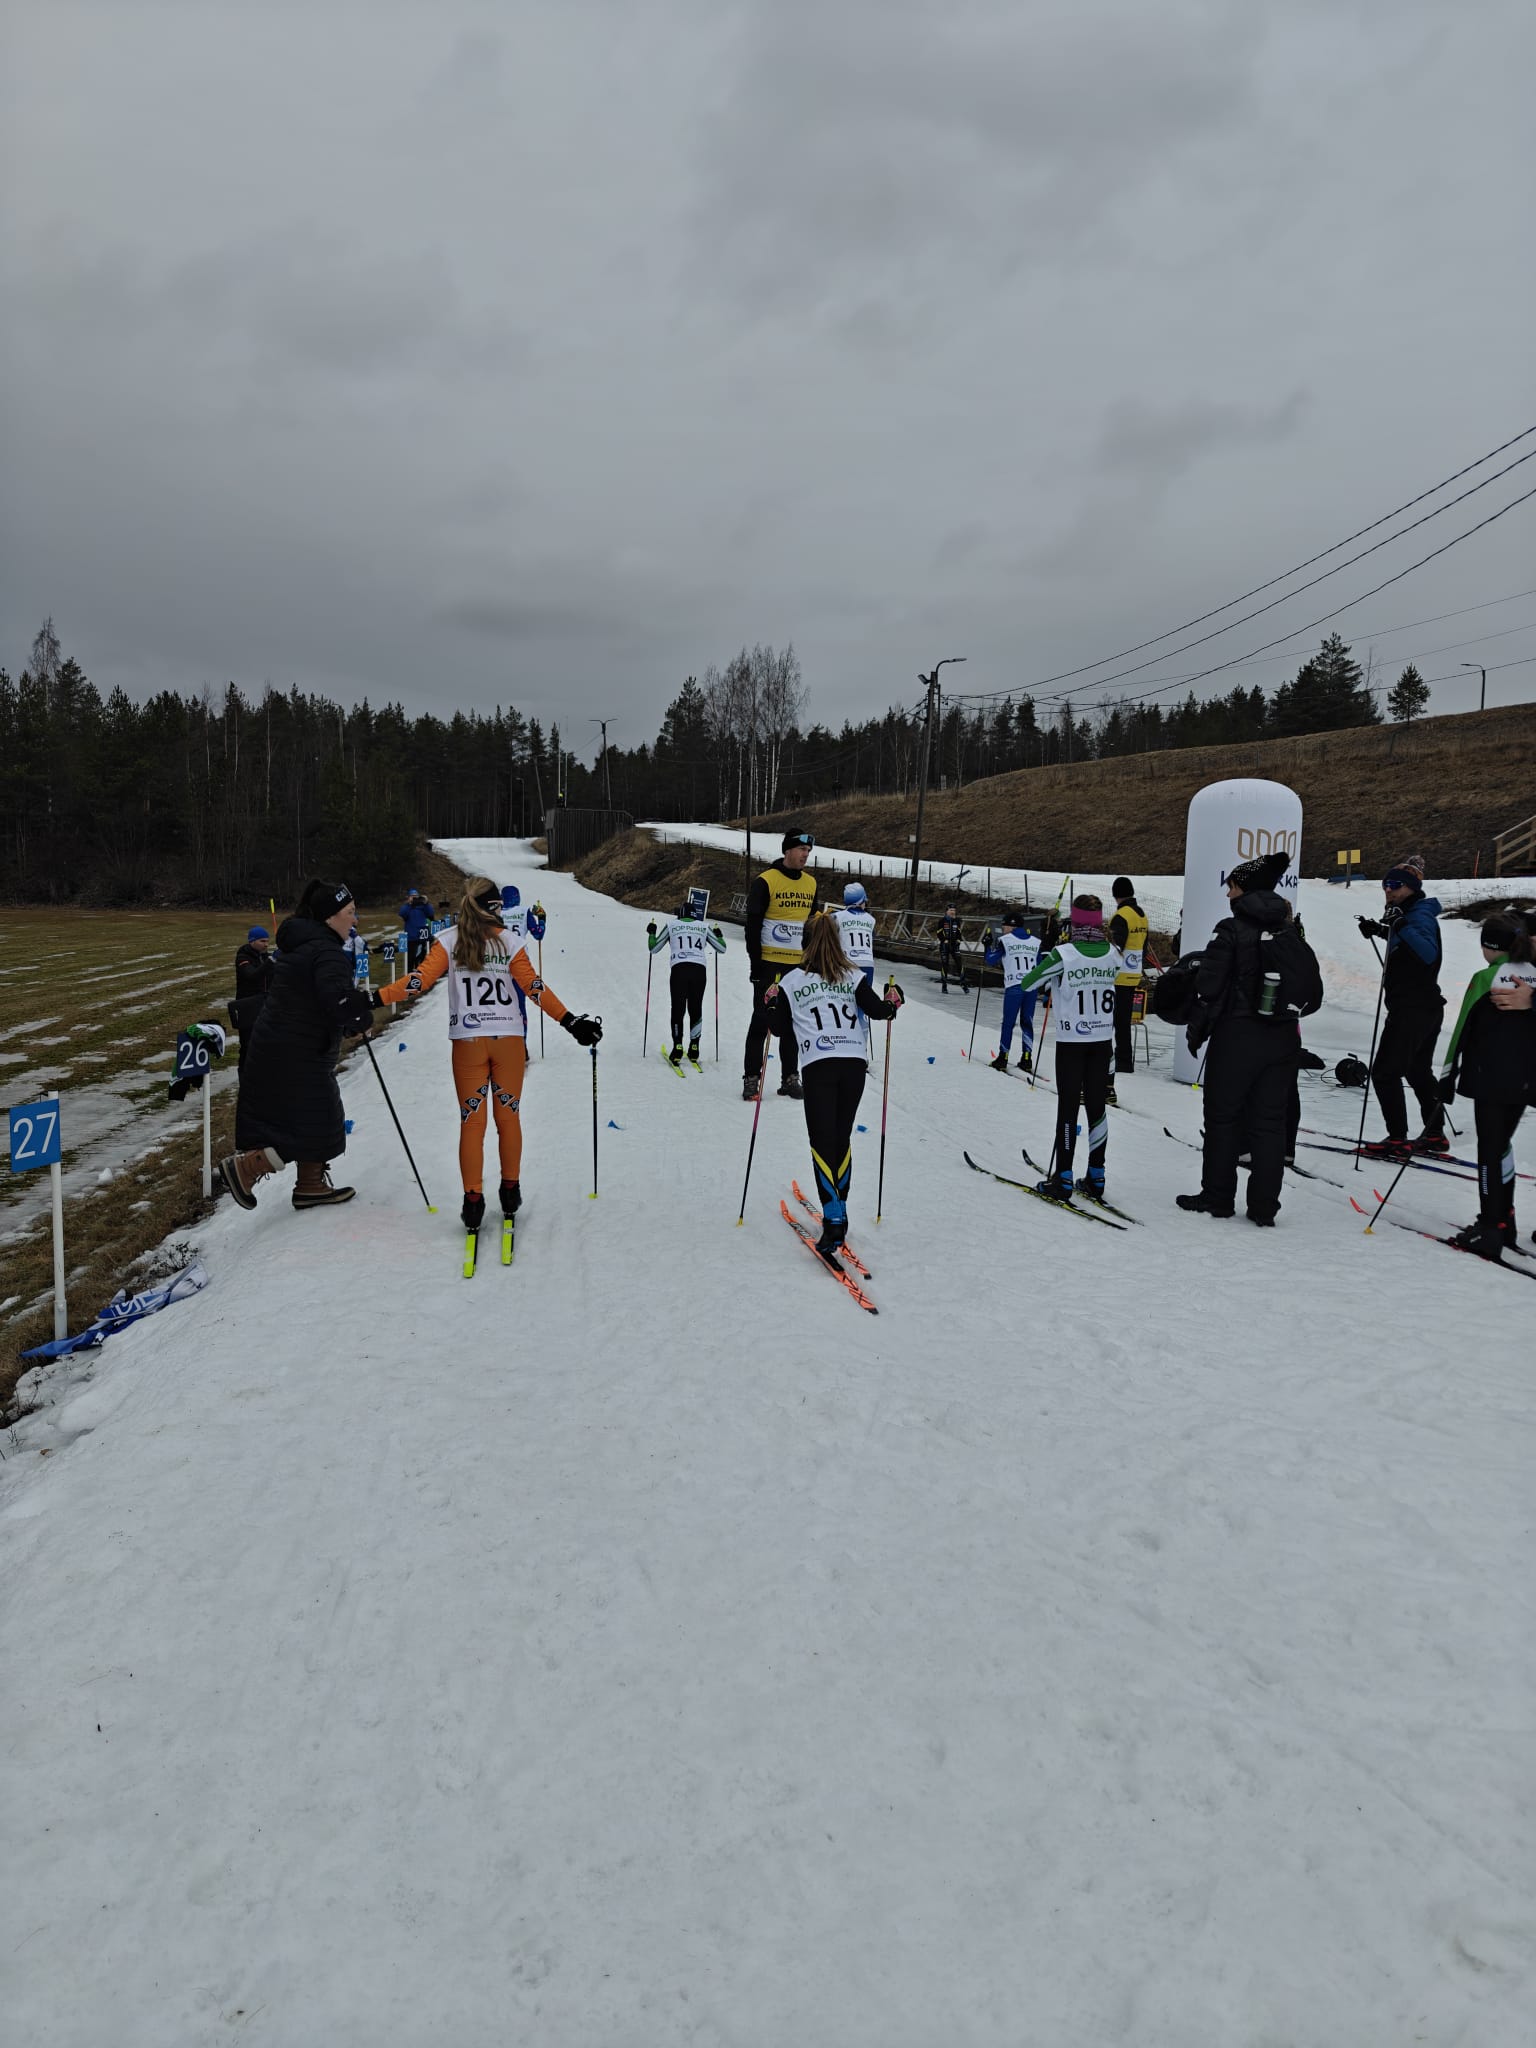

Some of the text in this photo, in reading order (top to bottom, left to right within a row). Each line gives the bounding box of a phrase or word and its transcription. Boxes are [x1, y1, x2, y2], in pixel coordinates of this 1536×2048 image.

[419, 928, 429, 940] 20
[678, 935, 703, 951] 114
[849, 932, 871, 948] 113
[383, 946, 395, 960] 22
[356, 957, 369, 973] 23
[1067, 967, 1090, 981] POP
[462, 976, 513, 1007] 120
[793, 982, 819, 1002] POP
[1077, 989, 1115, 1016] 118
[810, 1002, 858, 1031] 119
[179, 1039, 209, 1070] 26
[13, 1111, 57, 1161] 27
